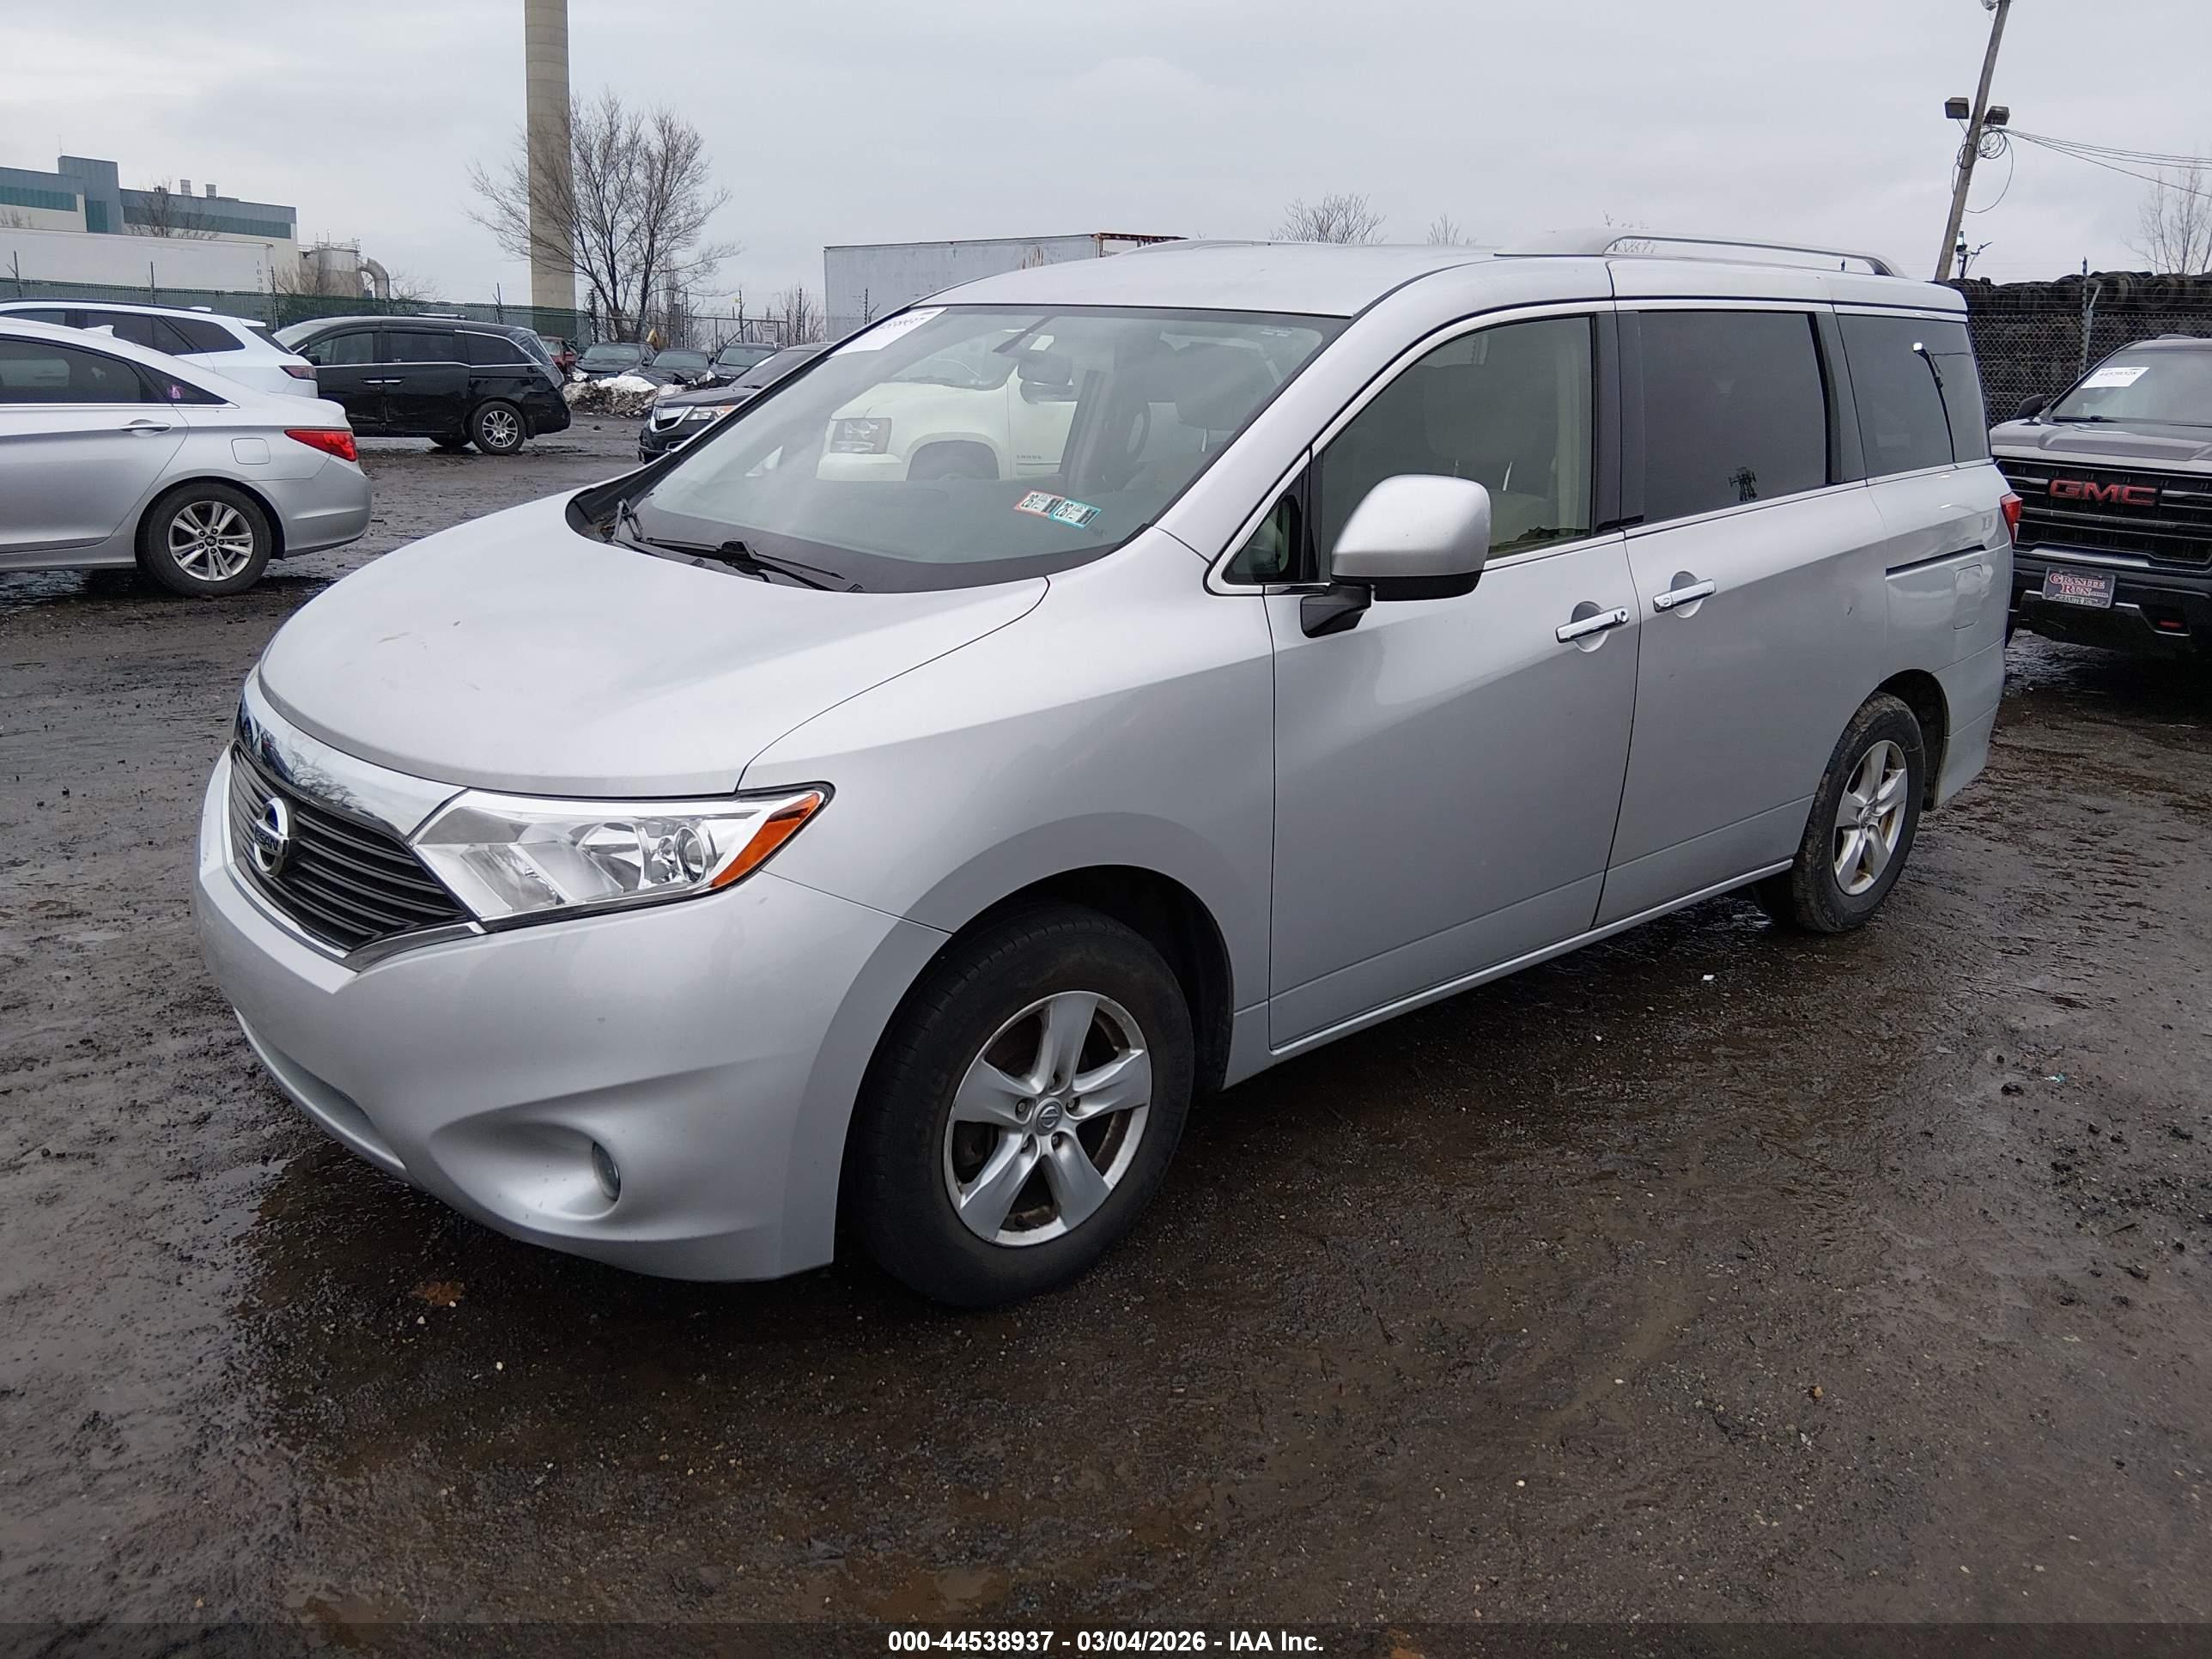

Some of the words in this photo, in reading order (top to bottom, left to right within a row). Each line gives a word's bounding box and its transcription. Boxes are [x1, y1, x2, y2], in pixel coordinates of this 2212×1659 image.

[2049, 479, 2156, 507] GMC
[2050, 573, 2106, 589] GRANITE
[2061, 584, 2092, 596] RUN
